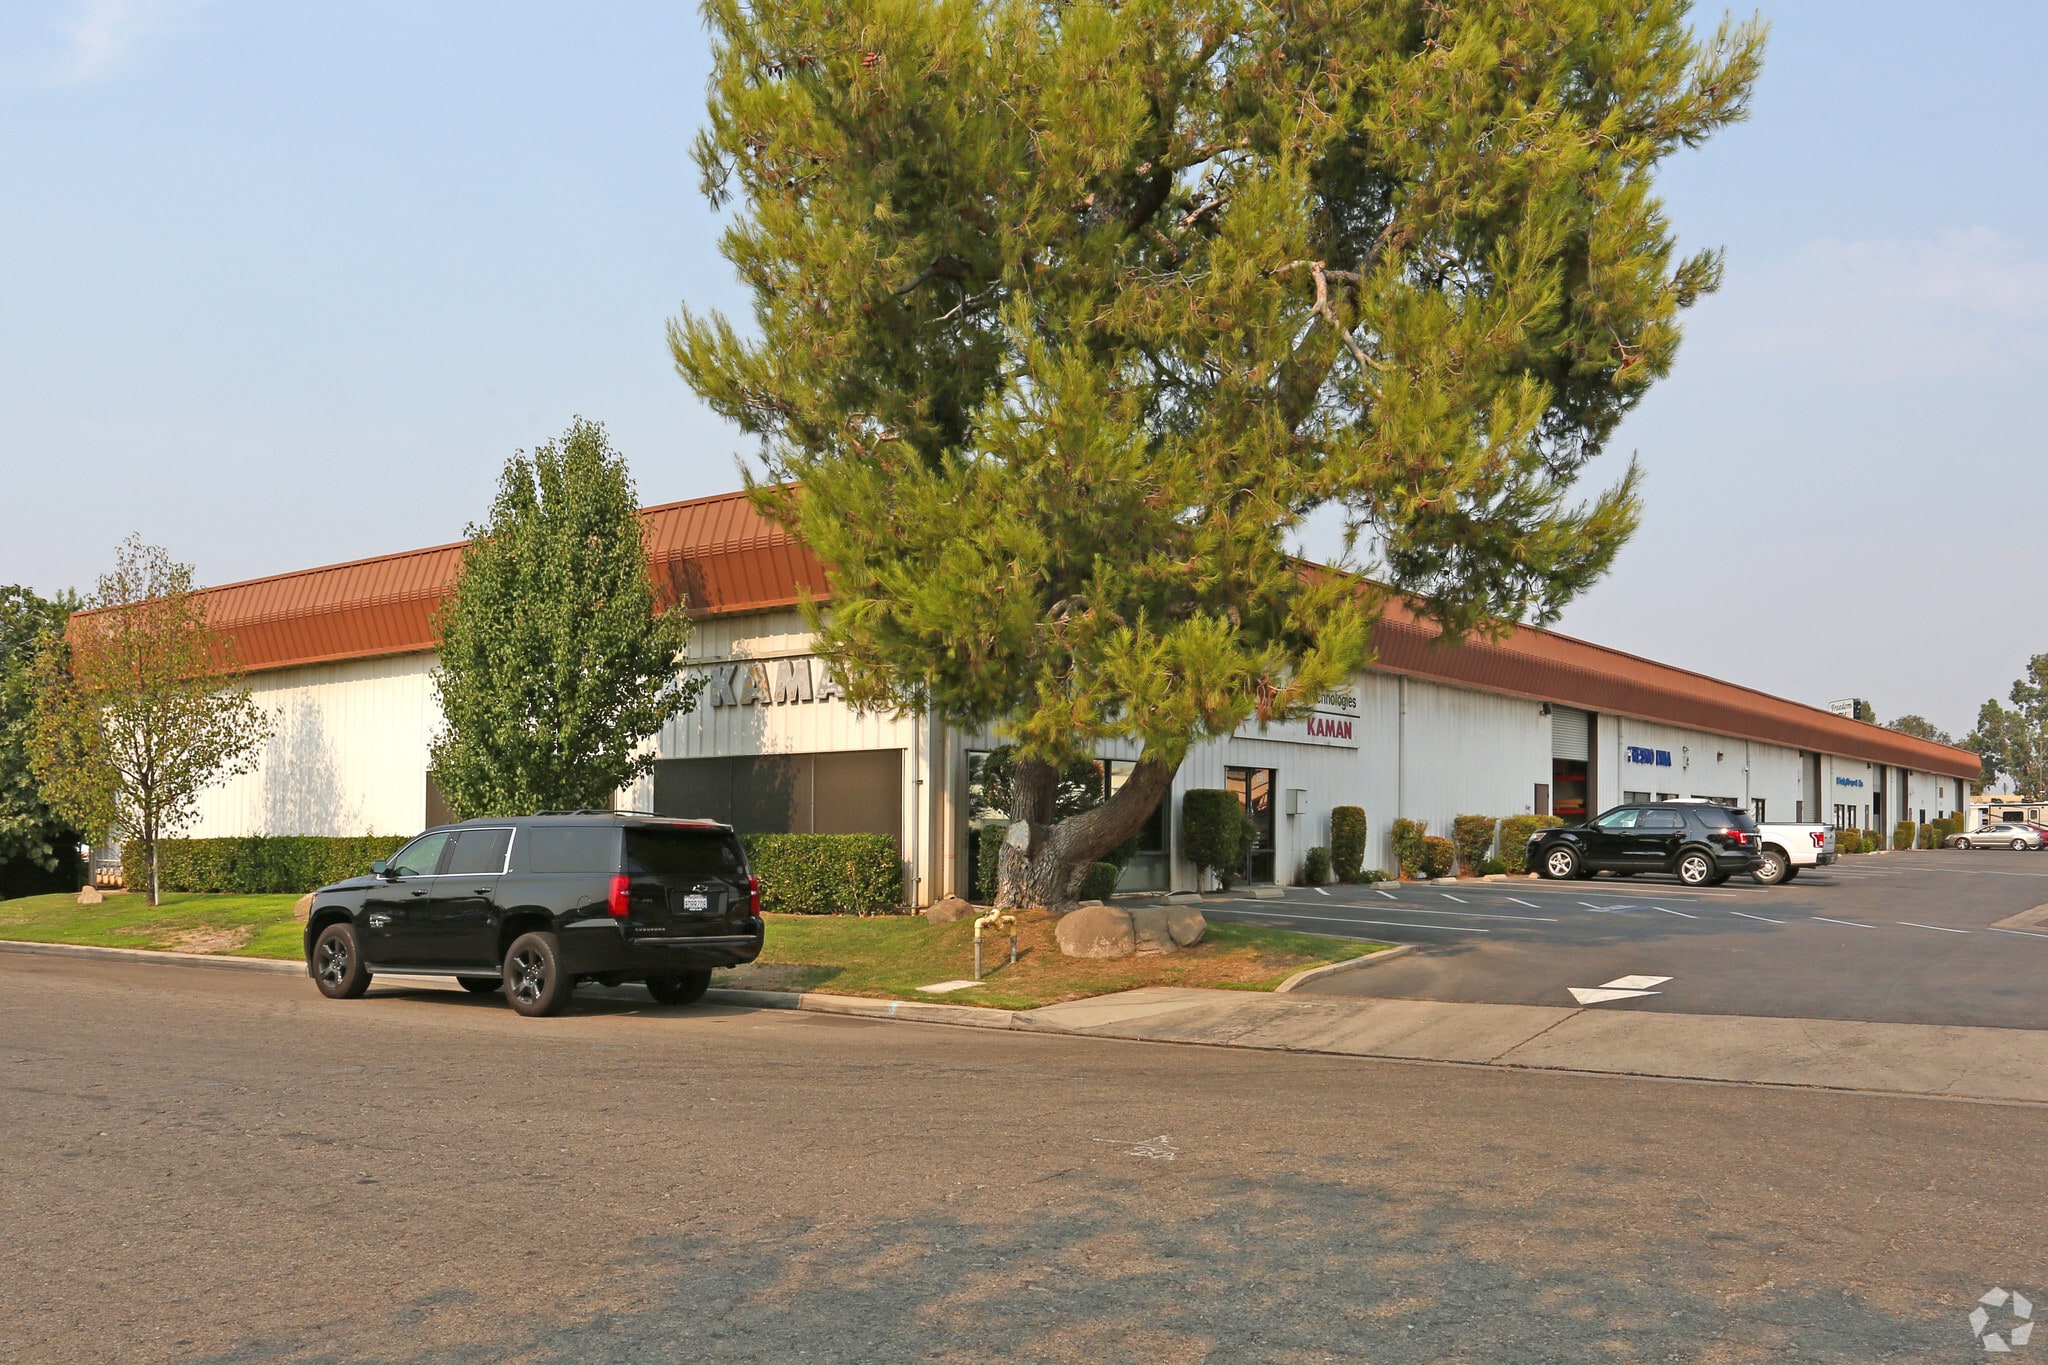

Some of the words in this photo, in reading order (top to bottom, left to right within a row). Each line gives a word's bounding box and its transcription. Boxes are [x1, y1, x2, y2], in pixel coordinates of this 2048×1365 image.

[710, 658, 846, 706] KAMA
[1316, 692, 1357, 710] chnologies
[1307, 717, 1352, 739] KAMAN
